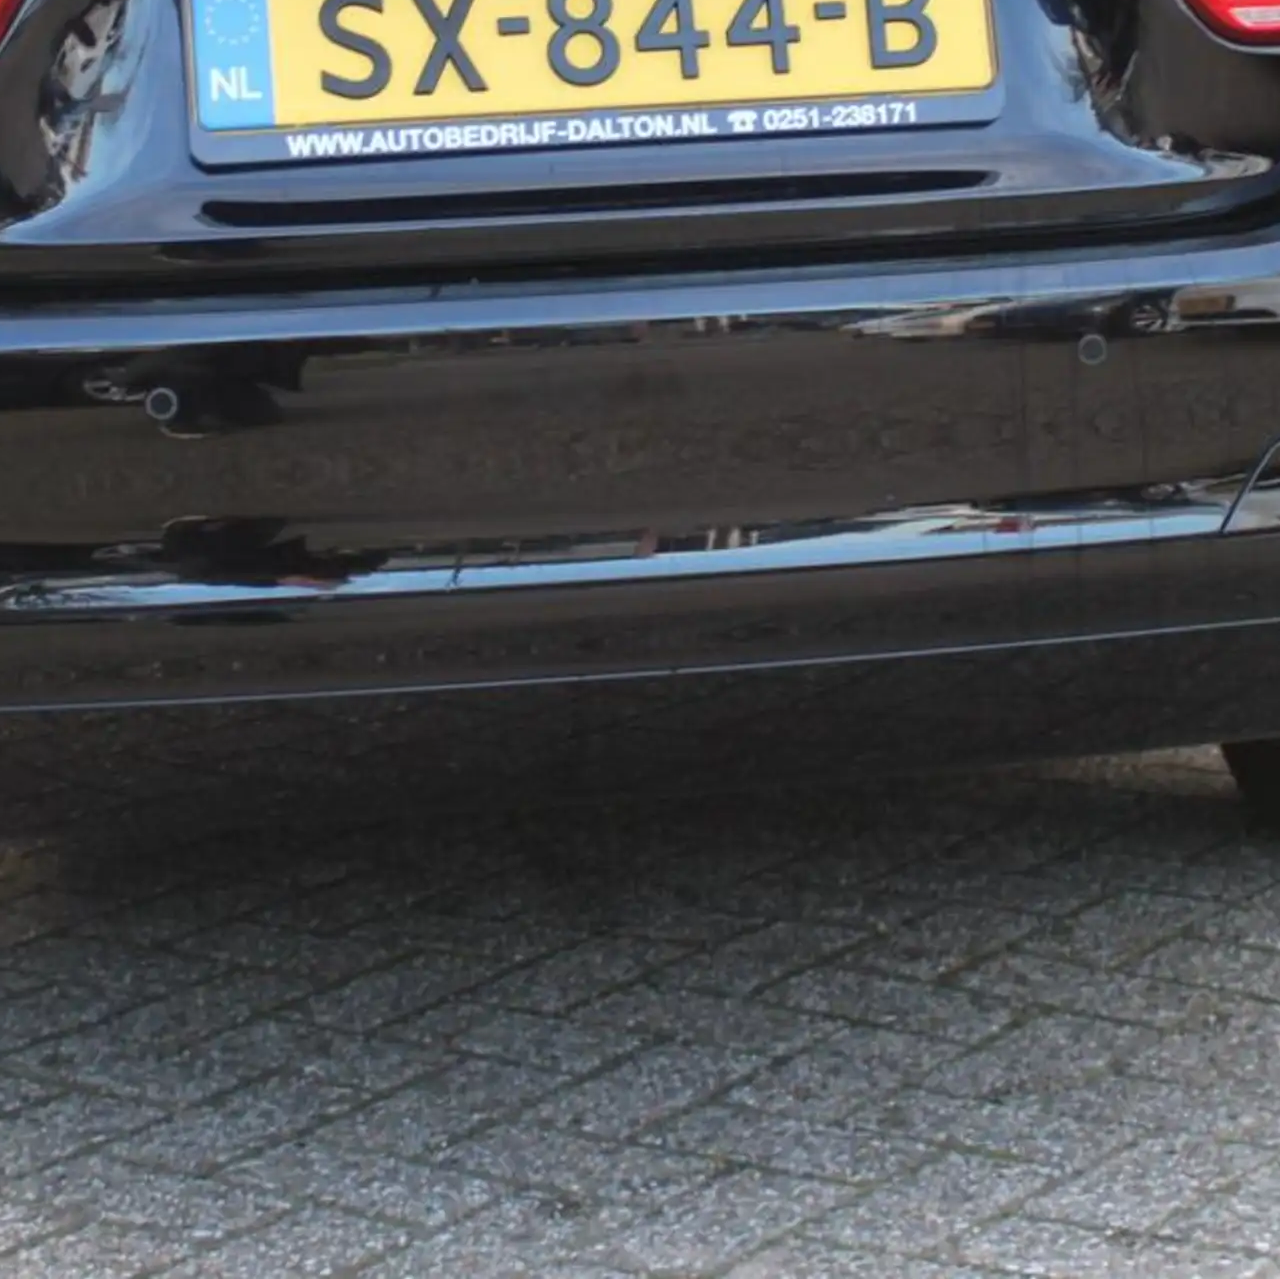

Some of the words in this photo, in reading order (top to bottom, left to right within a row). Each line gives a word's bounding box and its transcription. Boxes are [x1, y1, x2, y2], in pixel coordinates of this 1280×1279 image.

[210, 66, 263, 102] NL
[286, 112, 718, 157] WWW.AUTOBEDRIJF-DALTON.NL
[763, 101, 917, 131] 0251-238171
